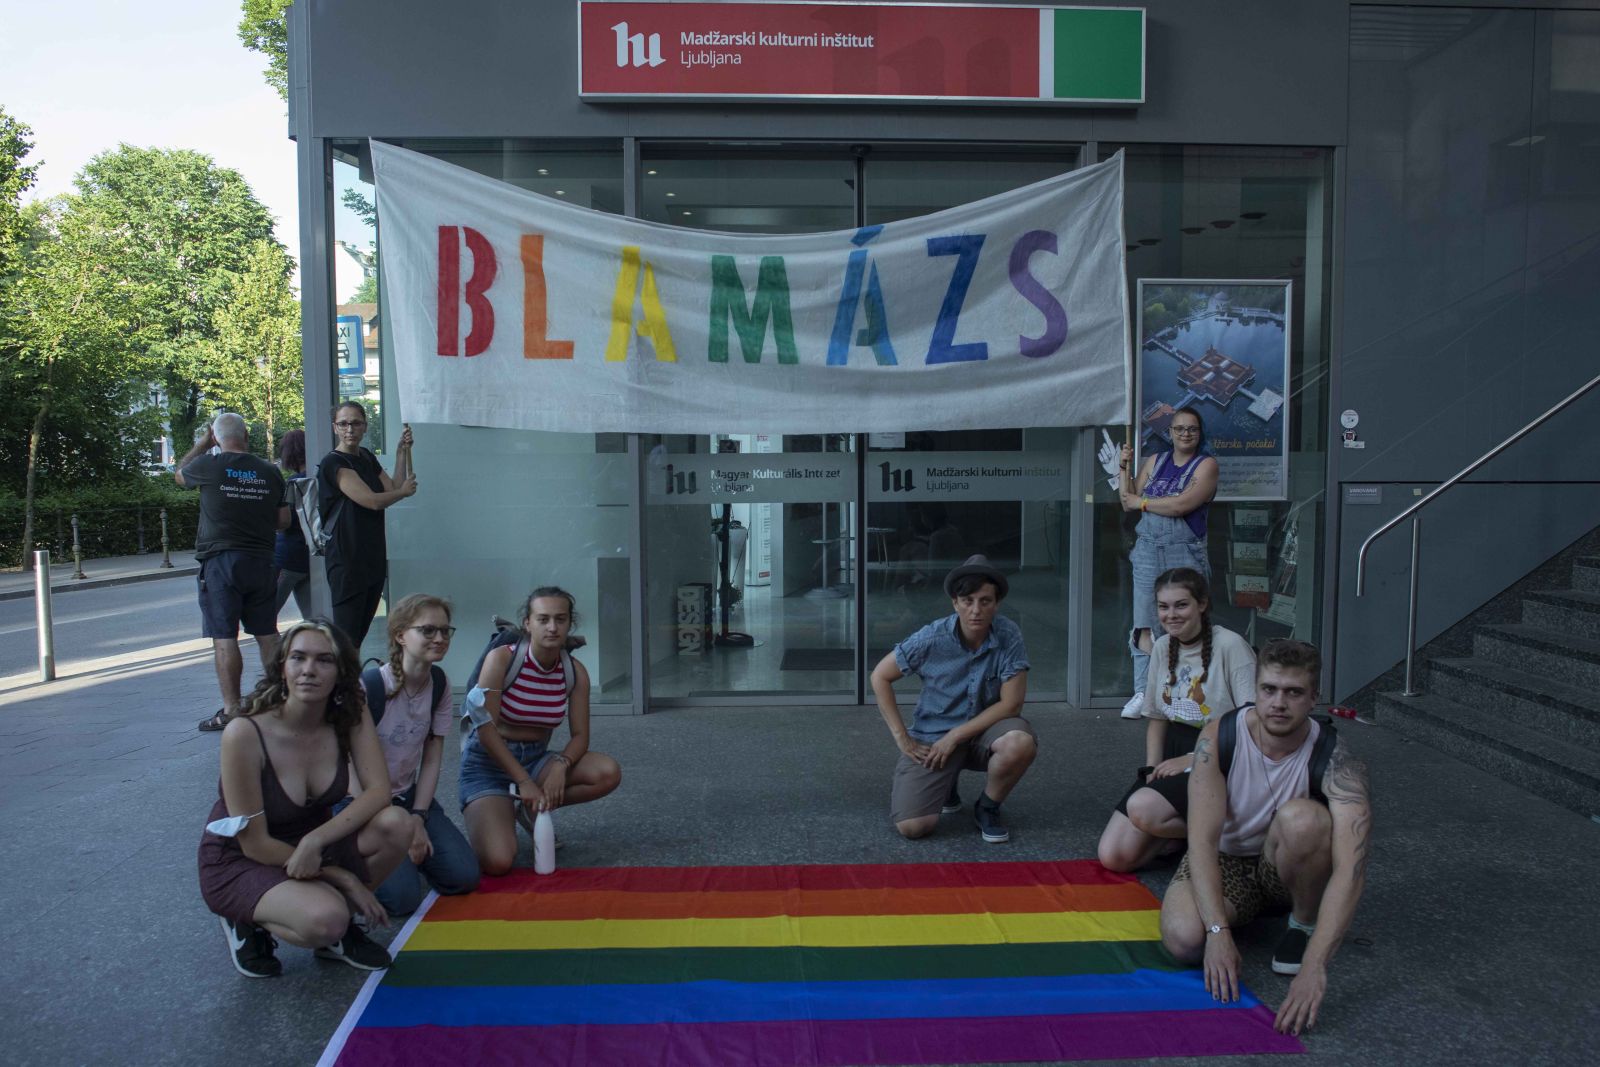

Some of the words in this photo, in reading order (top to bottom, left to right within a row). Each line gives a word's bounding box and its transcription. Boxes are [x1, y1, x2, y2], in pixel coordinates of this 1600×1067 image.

[610, 21, 667, 68] hu
[680, 31, 756, 47] Madžarski
[758, 32, 819, 47] kulturni
[820, 32, 874, 48] inštitut
[680, 50, 742, 66] Ljubljana
[225, 468, 252, 478] Total
[710, 469, 750, 481] Magyar
[753, 468, 802, 479] Kulturális
[877, 461, 917, 492] hu
[926, 466, 979, 477] Madžarski
[981, 467, 1023, 477] kulturni
[238, 477, 266, 485] system
[926, 480, 970, 492] Ljubljana
